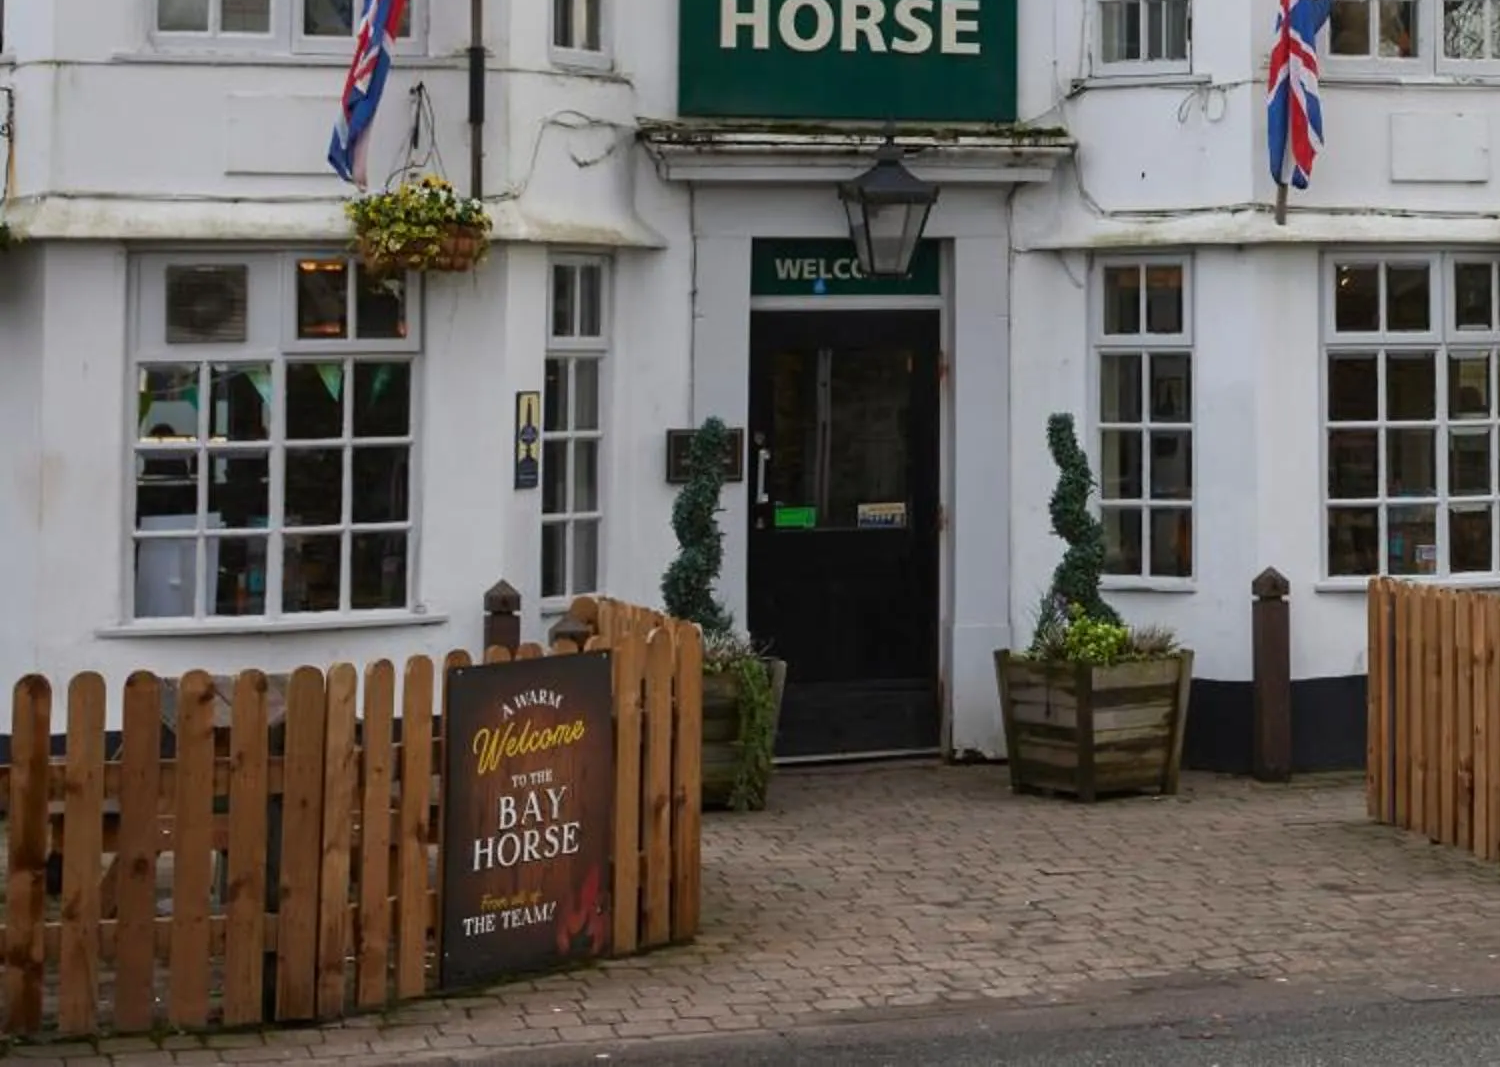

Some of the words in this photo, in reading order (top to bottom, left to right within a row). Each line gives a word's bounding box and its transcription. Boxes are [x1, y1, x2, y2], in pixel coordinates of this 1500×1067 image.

[514, 688, 564, 710] WARM
[472, 717, 586, 776] Welcome
[511, 774, 527, 789] TO
[529, 768, 554, 786] THE
[500, 786, 567, 831] BAY
[472, 821, 581, 872] HORSE
[462, 913, 496, 937] THE
[500, 900, 558, 931] TEAM!
